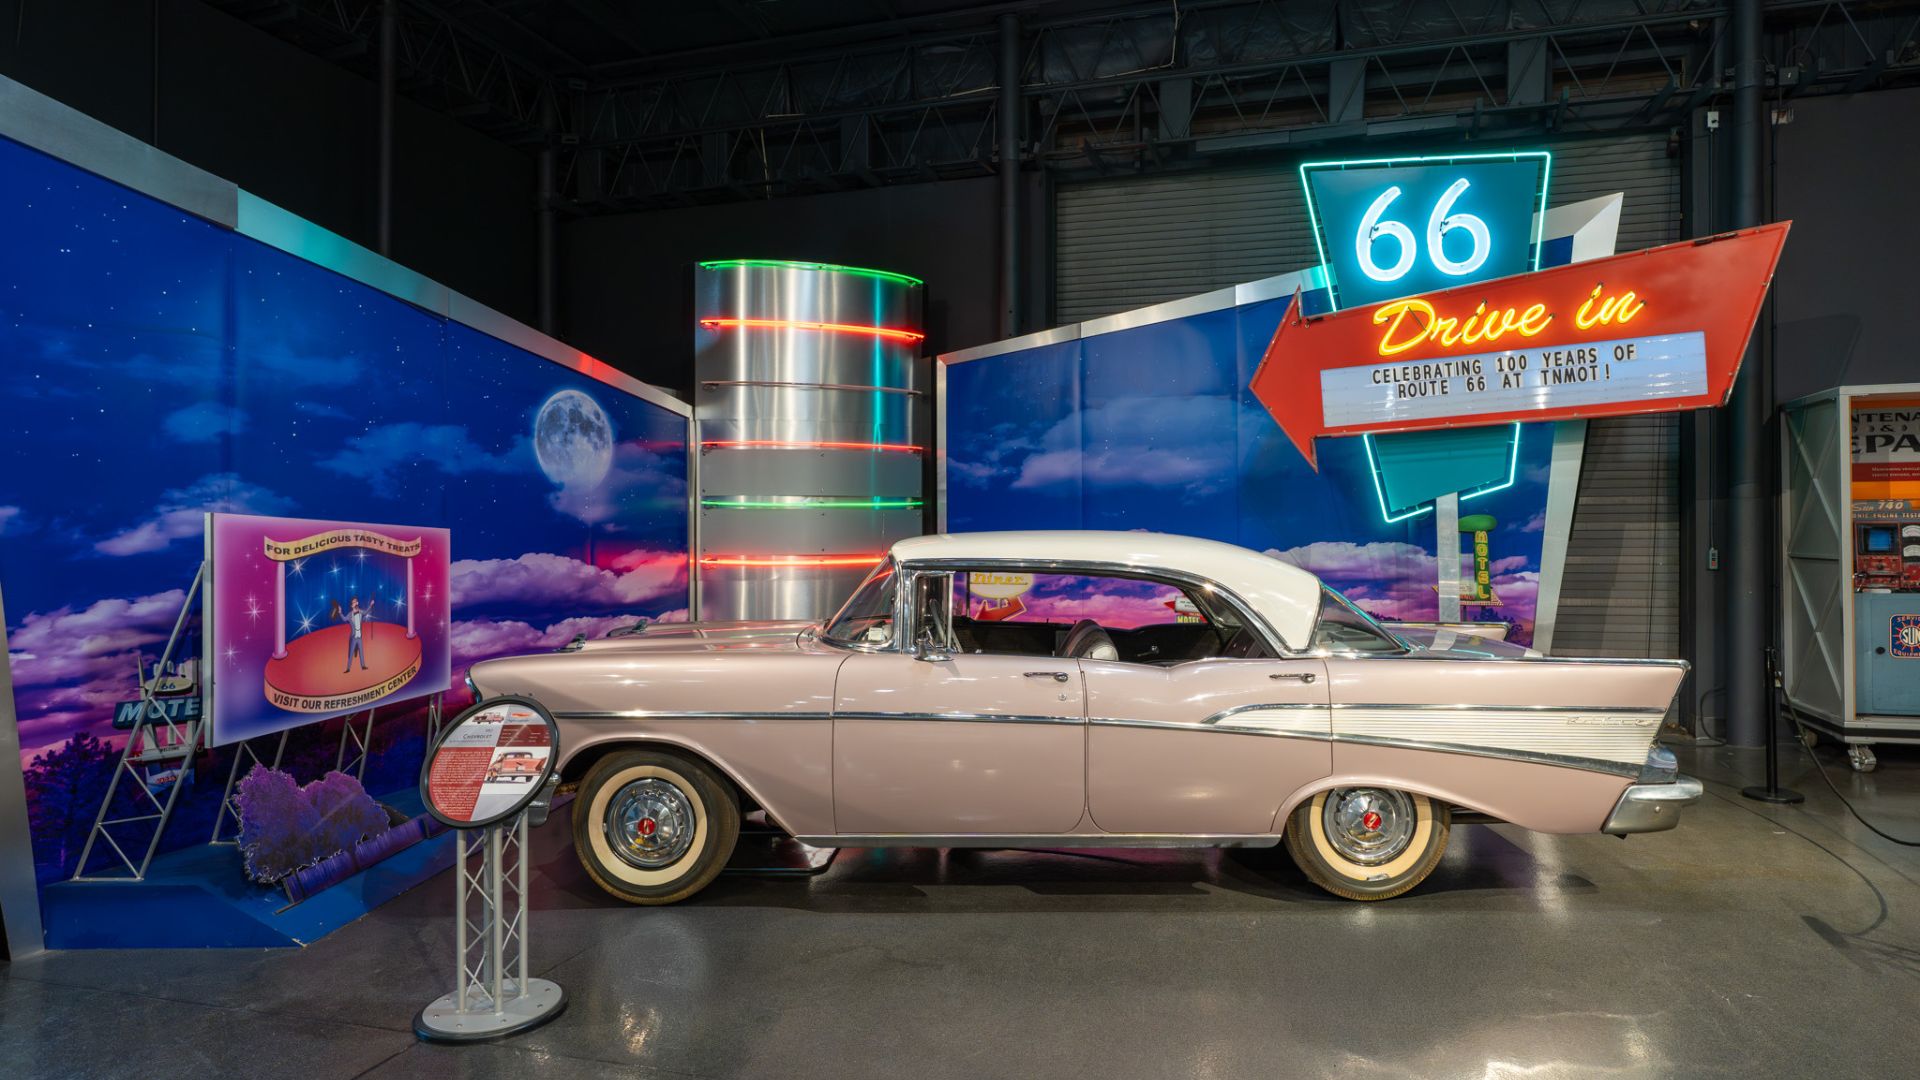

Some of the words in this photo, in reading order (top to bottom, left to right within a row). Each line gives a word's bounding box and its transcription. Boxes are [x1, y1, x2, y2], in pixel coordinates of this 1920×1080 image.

[1356, 178, 1491, 281] 66
[1373, 299, 1555, 356] Drive
[1576, 285, 1645, 330] in
[1373, 359, 1481, 384] CELEBRATING
[1497, 355, 1527, 372] 100
[1542, 348, 1597, 369] YEARS
[1614, 344, 1635, 361] OF
[1398, 381, 1448, 398] ROUTE
[1466, 376, 1486, 392] 66
[1503, 373, 1522, 389] AT
[1852, 412, 1920, 423] NTENA
[1852, 434, 1920, 453] EPA
[266, 544, 291, 555] FOR
[294, 535, 352, 554] DELICIOUS
[354, 534, 384, 547] TASTY
[387, 542, 420, 553] TREATS
[1475, 531, 1489, 599] MOTEL
[273, 693, 299, 708] VISIT
[302, 699, 321, 709] OUR
[324, 686, 386, 709] REFRESHMENT
[388, 665, 417, 690] CENTER
[117, 698, 201, 722] MOTE
